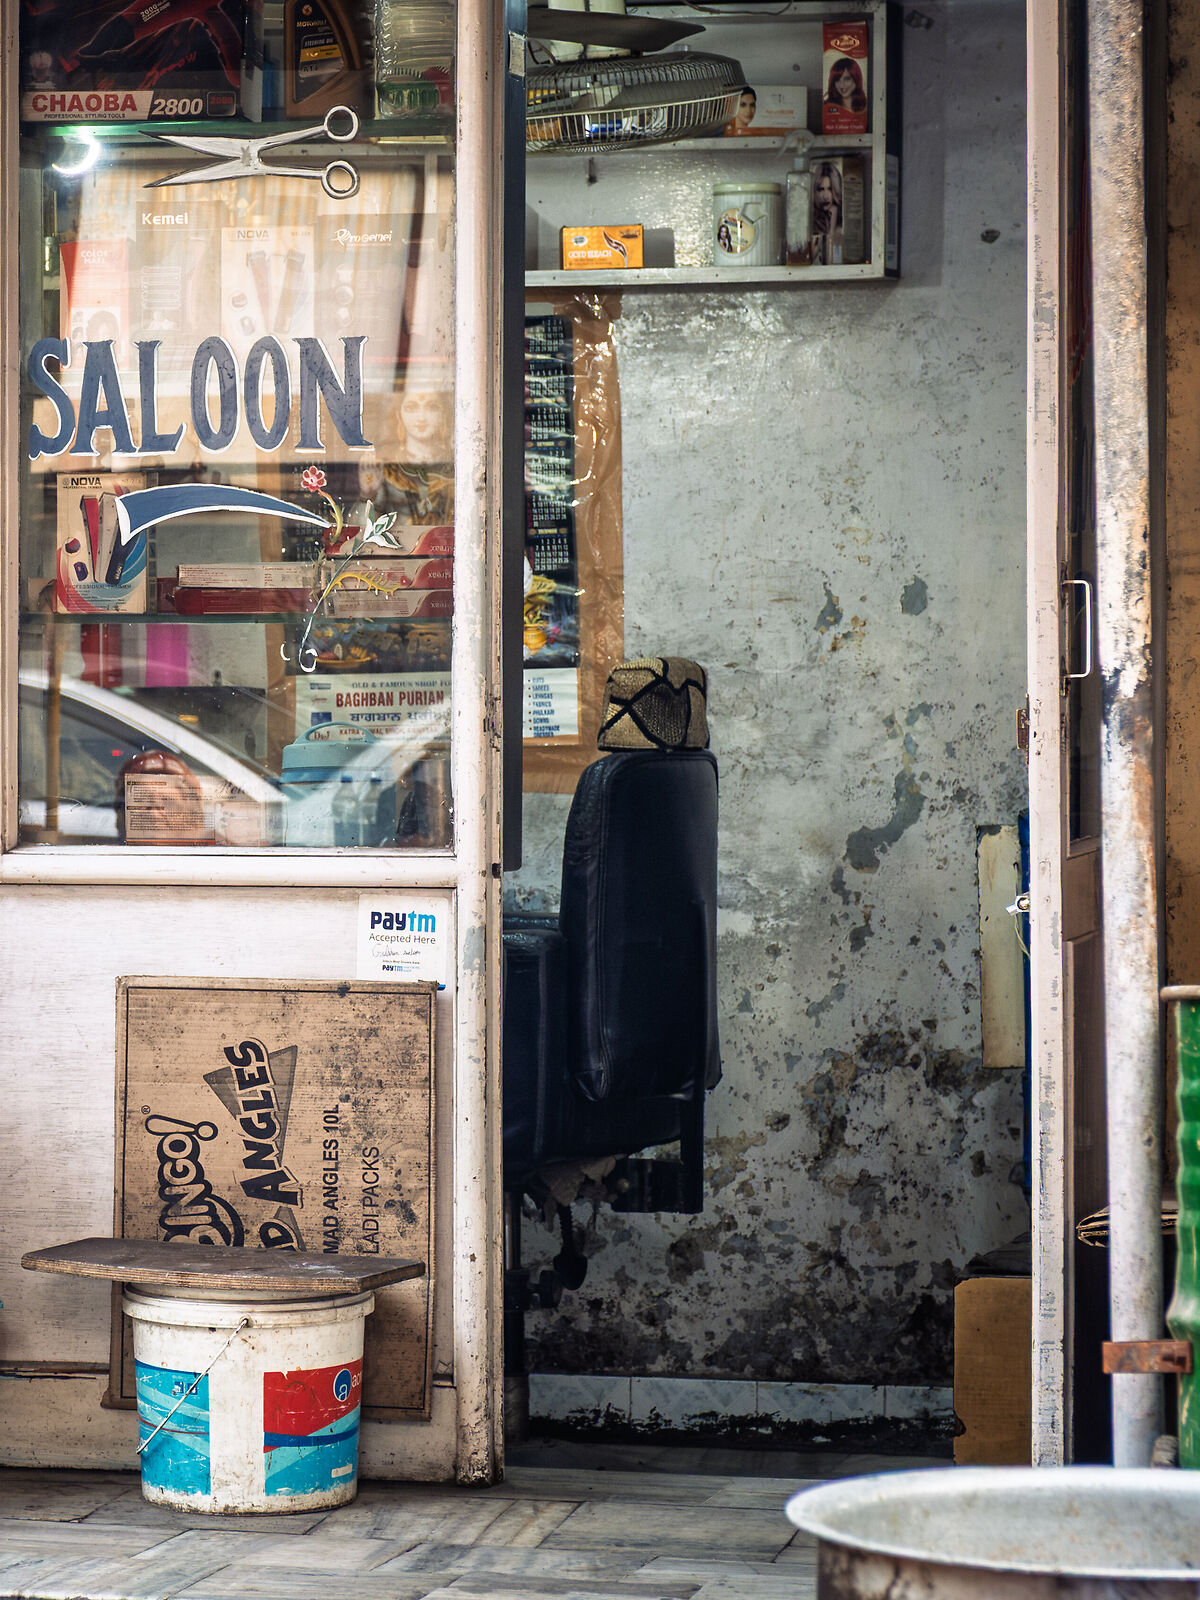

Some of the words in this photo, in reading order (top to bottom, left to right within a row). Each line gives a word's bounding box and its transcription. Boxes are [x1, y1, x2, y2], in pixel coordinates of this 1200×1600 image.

[31, 94, 138, 113] CHAOBA
[151, 98, 204, 116] 2800
[237, 230, 270, 239] NOVA
[28, 335, 376, 461] SALOON
[70, 477, 102, 486] NOVA
[335, 691, 394, 708] BAGHBAN
[399, 690, 445, 707] PURIAN
[370, 910, 437, 933] paytm
[368, 933, 412, 944] Accepted
[413, 936, 437, 945] Here
[224, 1037, 303, 1209] ANGLES
[322, 1104, 339, 1134] 10L
[322, 1138, 339, 1212] ANGLES
[361, 1146, 380, 1208] PACKS
[322, 1215, 339, 1255] MAD
[361, 1213, 380, 1255] LADI
